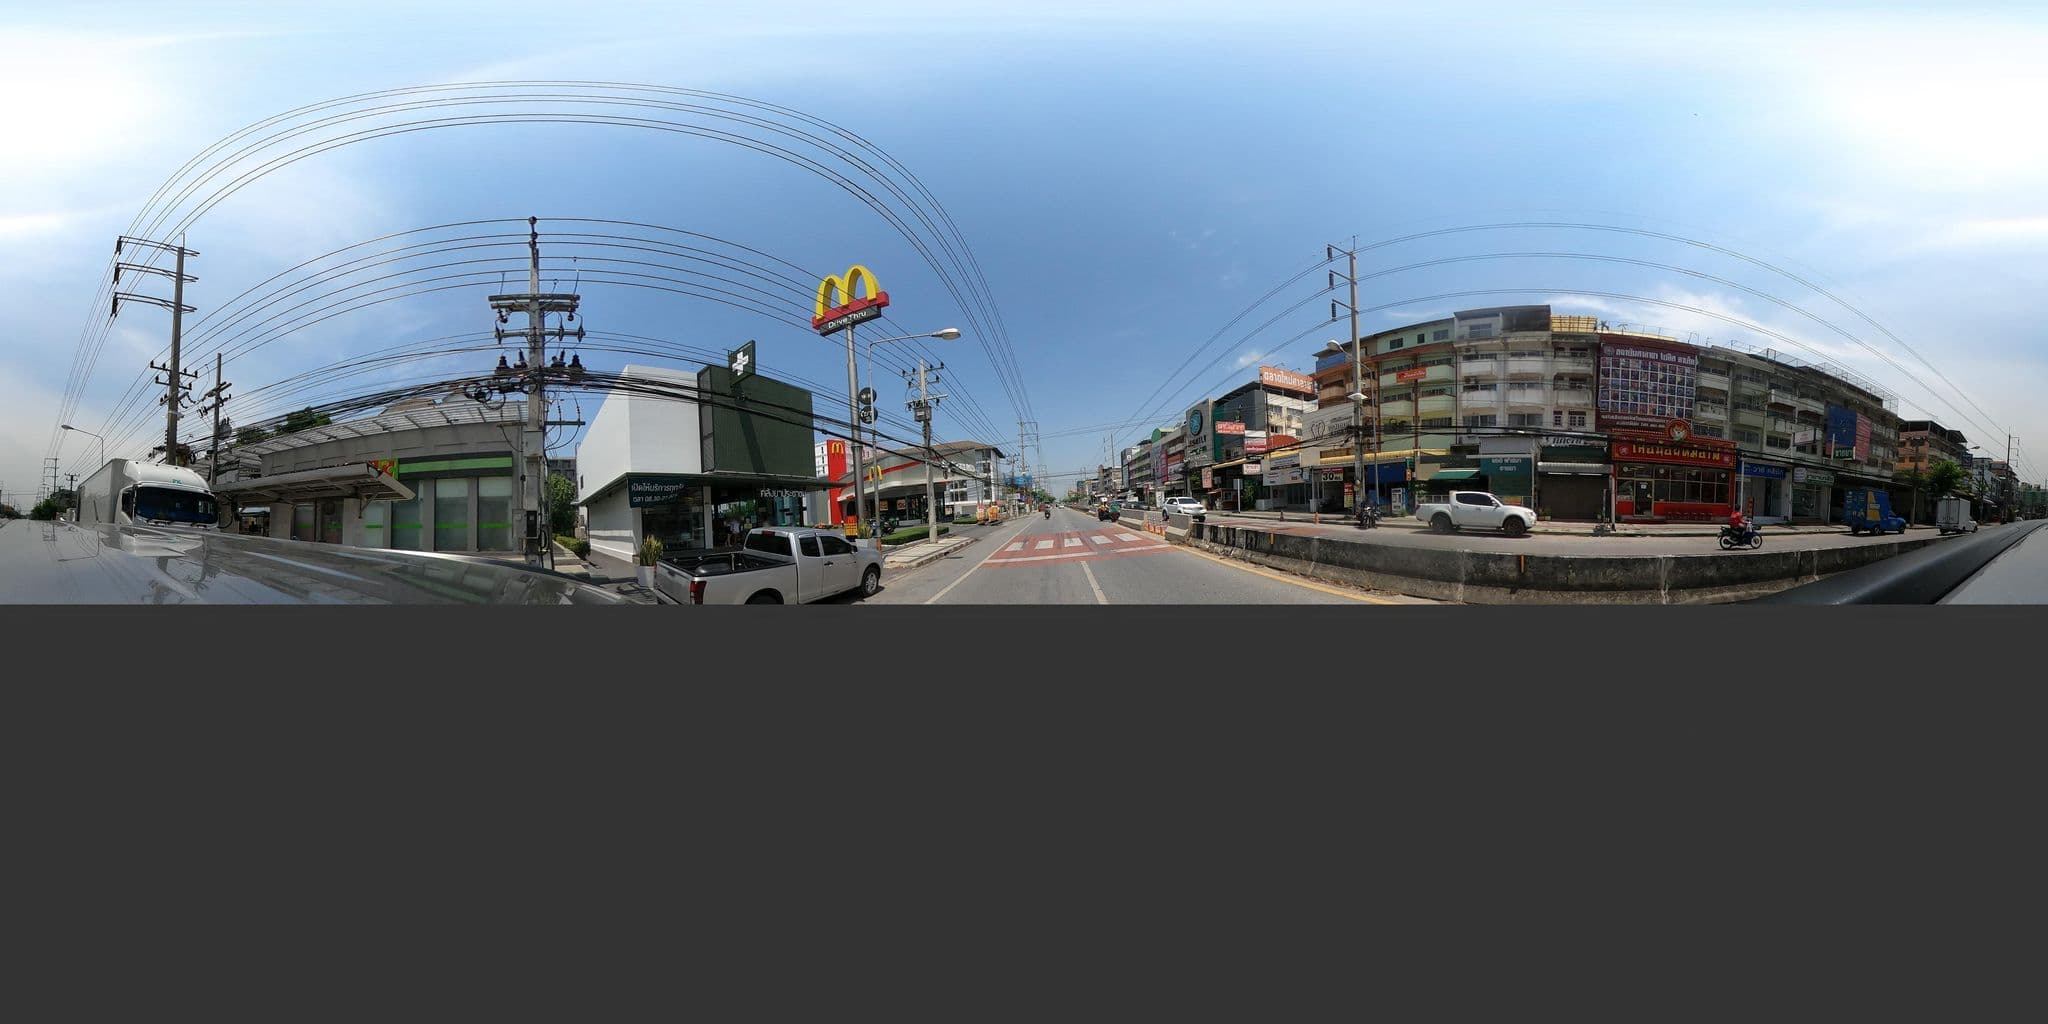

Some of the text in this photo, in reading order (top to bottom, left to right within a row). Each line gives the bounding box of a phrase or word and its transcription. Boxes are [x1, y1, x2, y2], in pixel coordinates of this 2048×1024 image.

[828, 311, 867, 329] Drive Thru
[1322, 472, 1334, 481] 30
